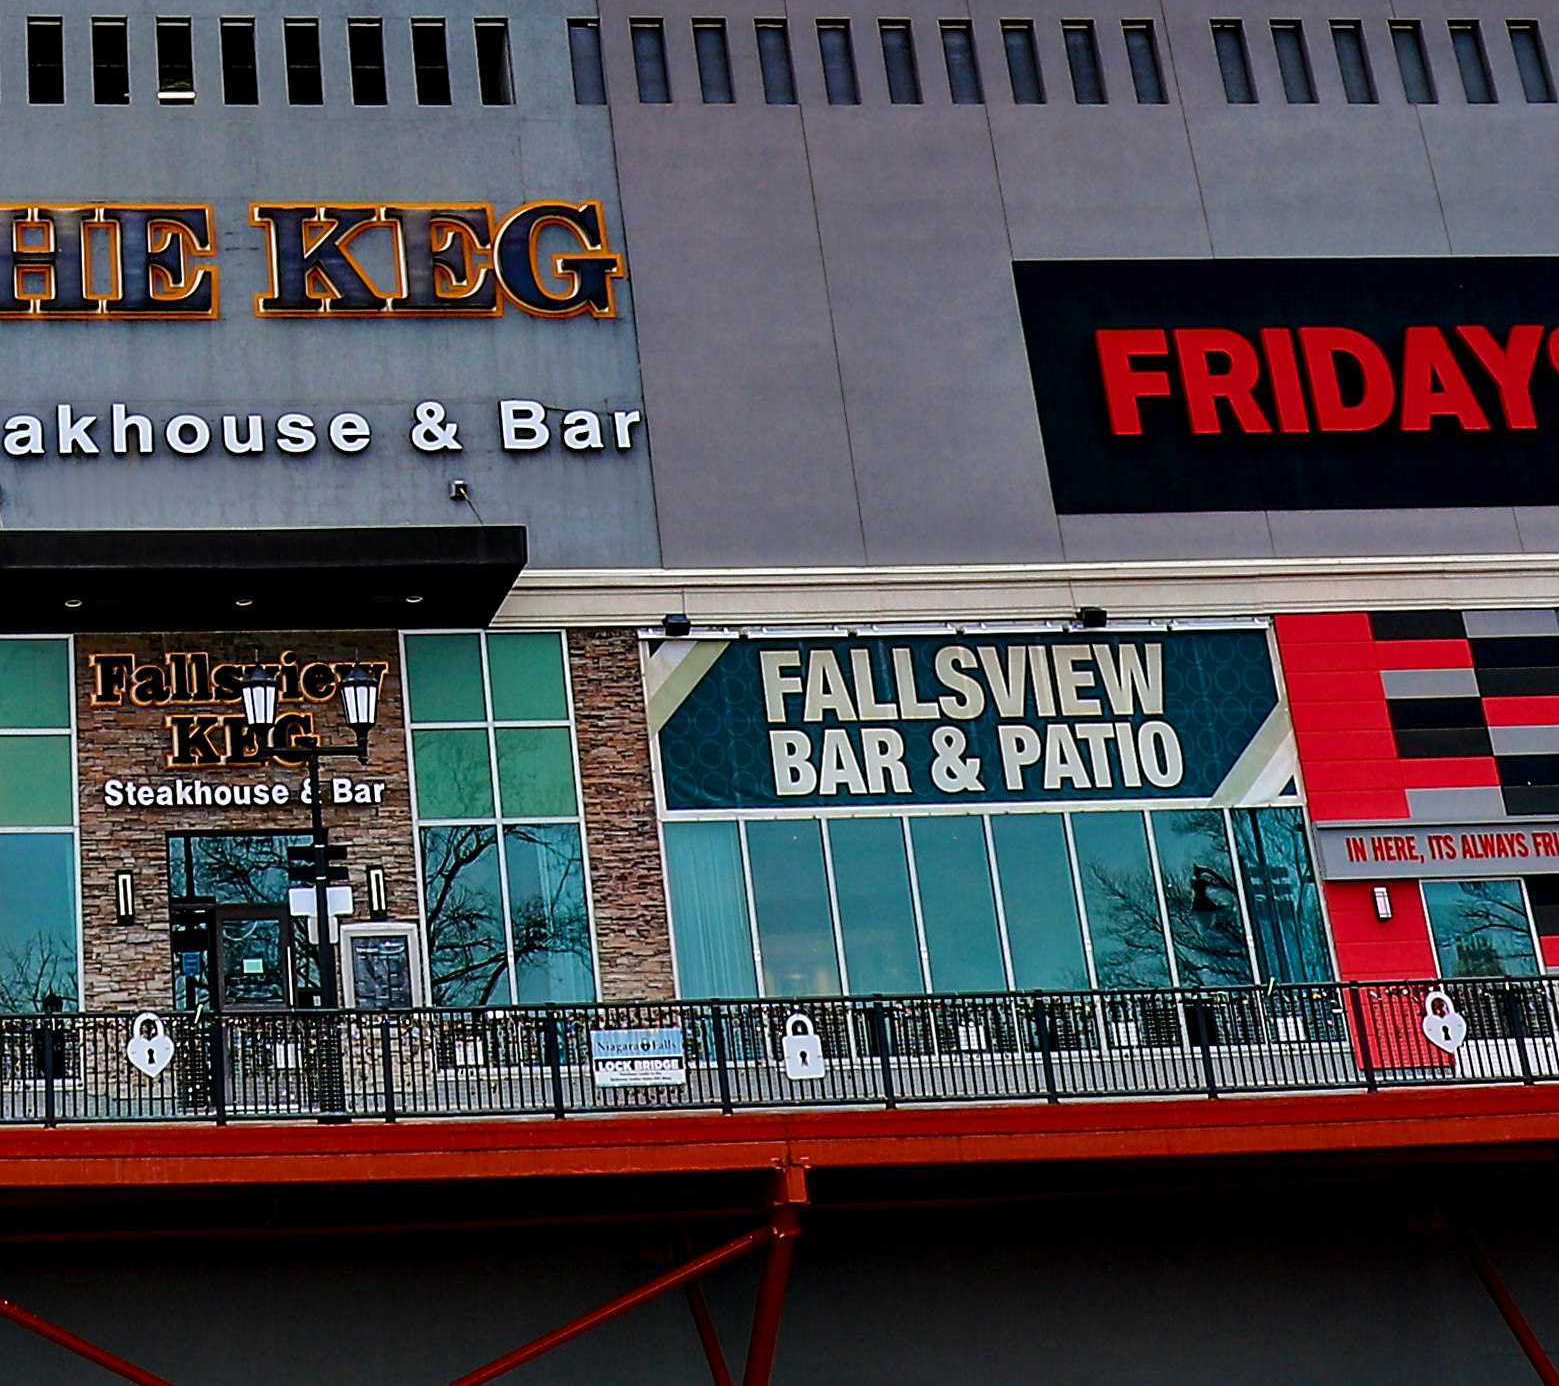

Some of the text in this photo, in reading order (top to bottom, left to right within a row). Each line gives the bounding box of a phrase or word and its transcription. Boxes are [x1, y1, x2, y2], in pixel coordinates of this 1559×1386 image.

[248, 201, 623, 319] KEG
[411, 400, 464, 452] &
[499, 398, 642, 451] Bar
[760, 642, 1165, 723] FALLSVIEW
[769, 720, 1184, 797] BAR & PATIO
[104, 778, 290, 807] Steakhouse
[332, 777, 387, 804] Bar
[1345, 836, 1368, 863] IN
[1371, 835, 1425, 864] HERE,
[1428, 834, 1458, 861] ITS
[1461, 832, 1530, 860] ALWAYS
[597, 1040, 639, 1054] Niagara
[598, 1059, 680, 1072] LOCK BRIDGE
